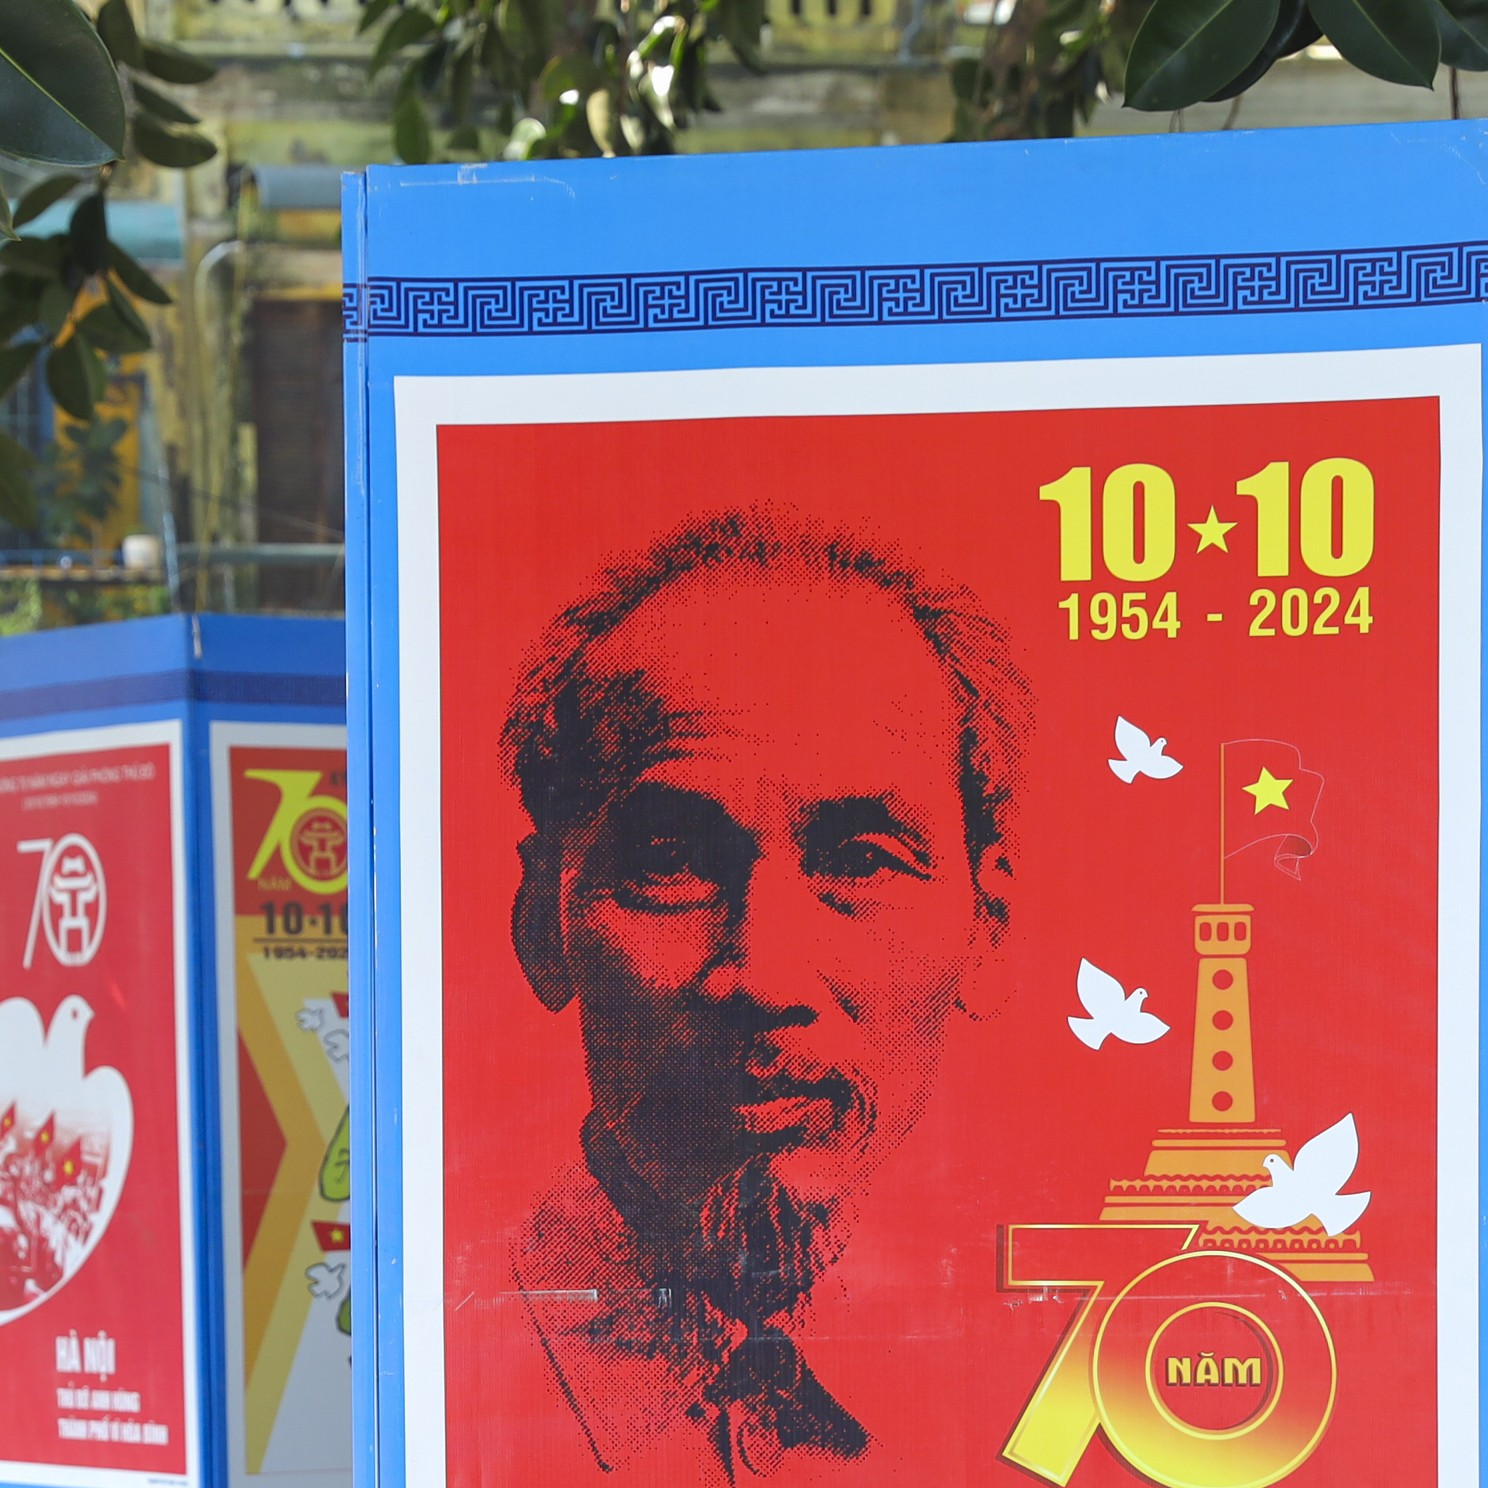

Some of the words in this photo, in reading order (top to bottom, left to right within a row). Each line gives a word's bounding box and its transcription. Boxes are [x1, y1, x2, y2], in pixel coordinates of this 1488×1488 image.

[1038, 462, 1176, 583] 10
[1235, 457, 1375, 577] 10
[1058, 591, 1181, 641] 1954
[1248, 586, 1374, 637] 2024
[1165, 1352, 1262, 1387] NĂM
